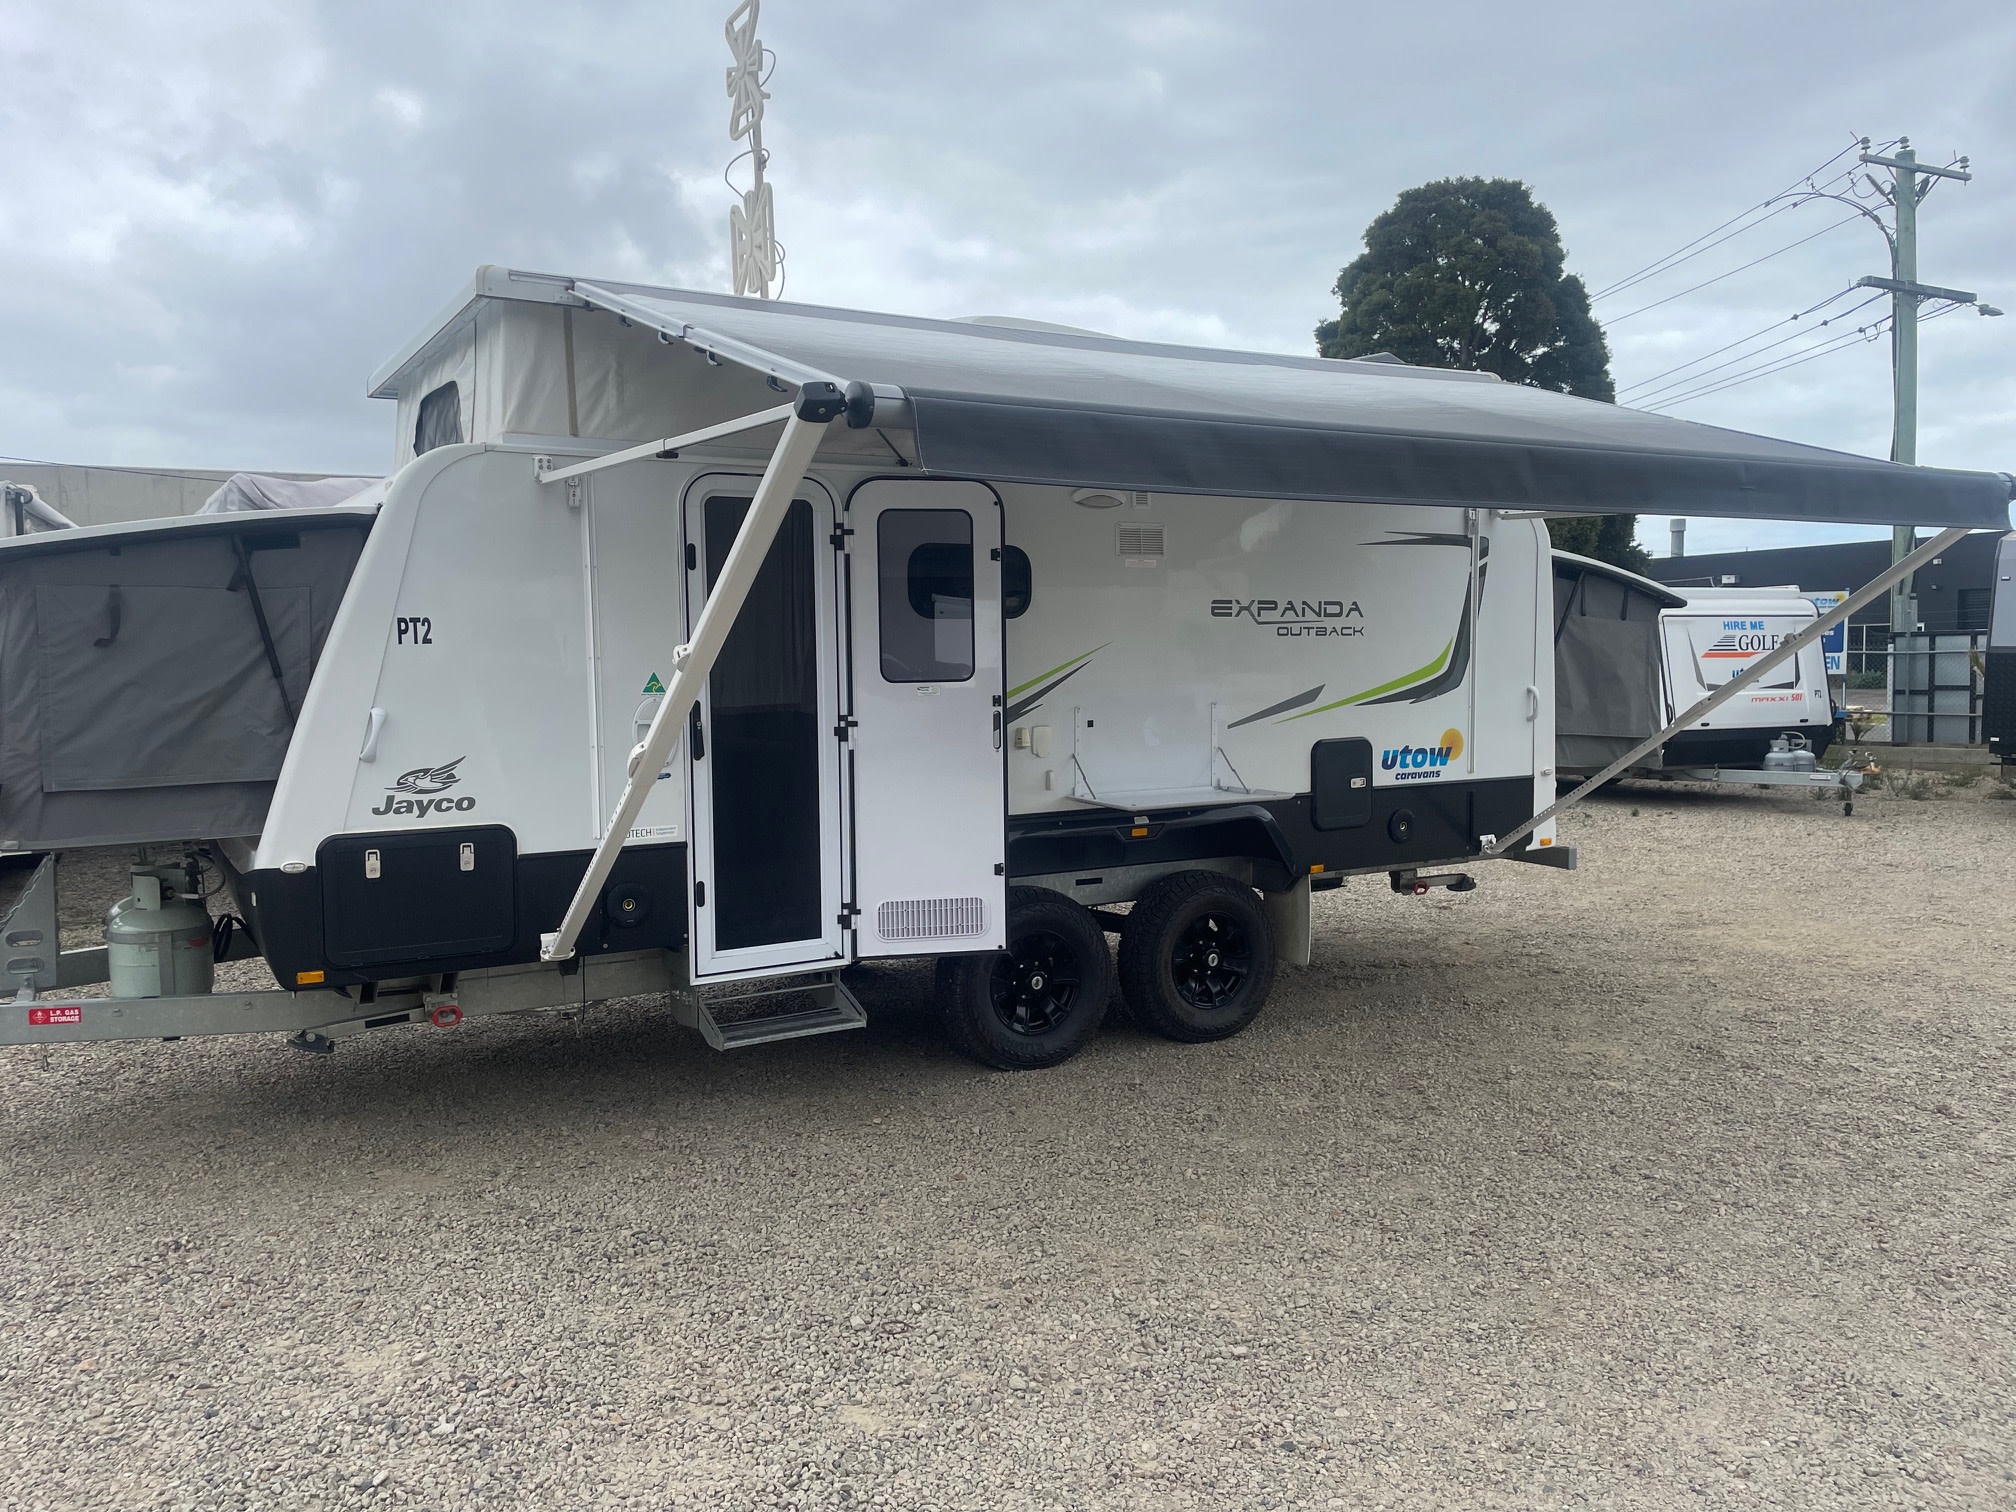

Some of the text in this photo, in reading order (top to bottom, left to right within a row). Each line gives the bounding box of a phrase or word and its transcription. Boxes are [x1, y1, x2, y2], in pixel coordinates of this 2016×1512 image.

[1210, 599, 1364, 624] EXPANDA
[396, 616, 433, 645] PT2
[1276, 626, 1365, 637] OUTBACK
[1723, 621, 1764, 630] HIRE ME
[1738, 634, 1780, 651] GOLF
[1791, 693, 1803, 702] 501
[1381, 744, 1453, 770] utow
[1394, 769, 1442, 781] caravans
[371, 794, 476, 819] Jayco
